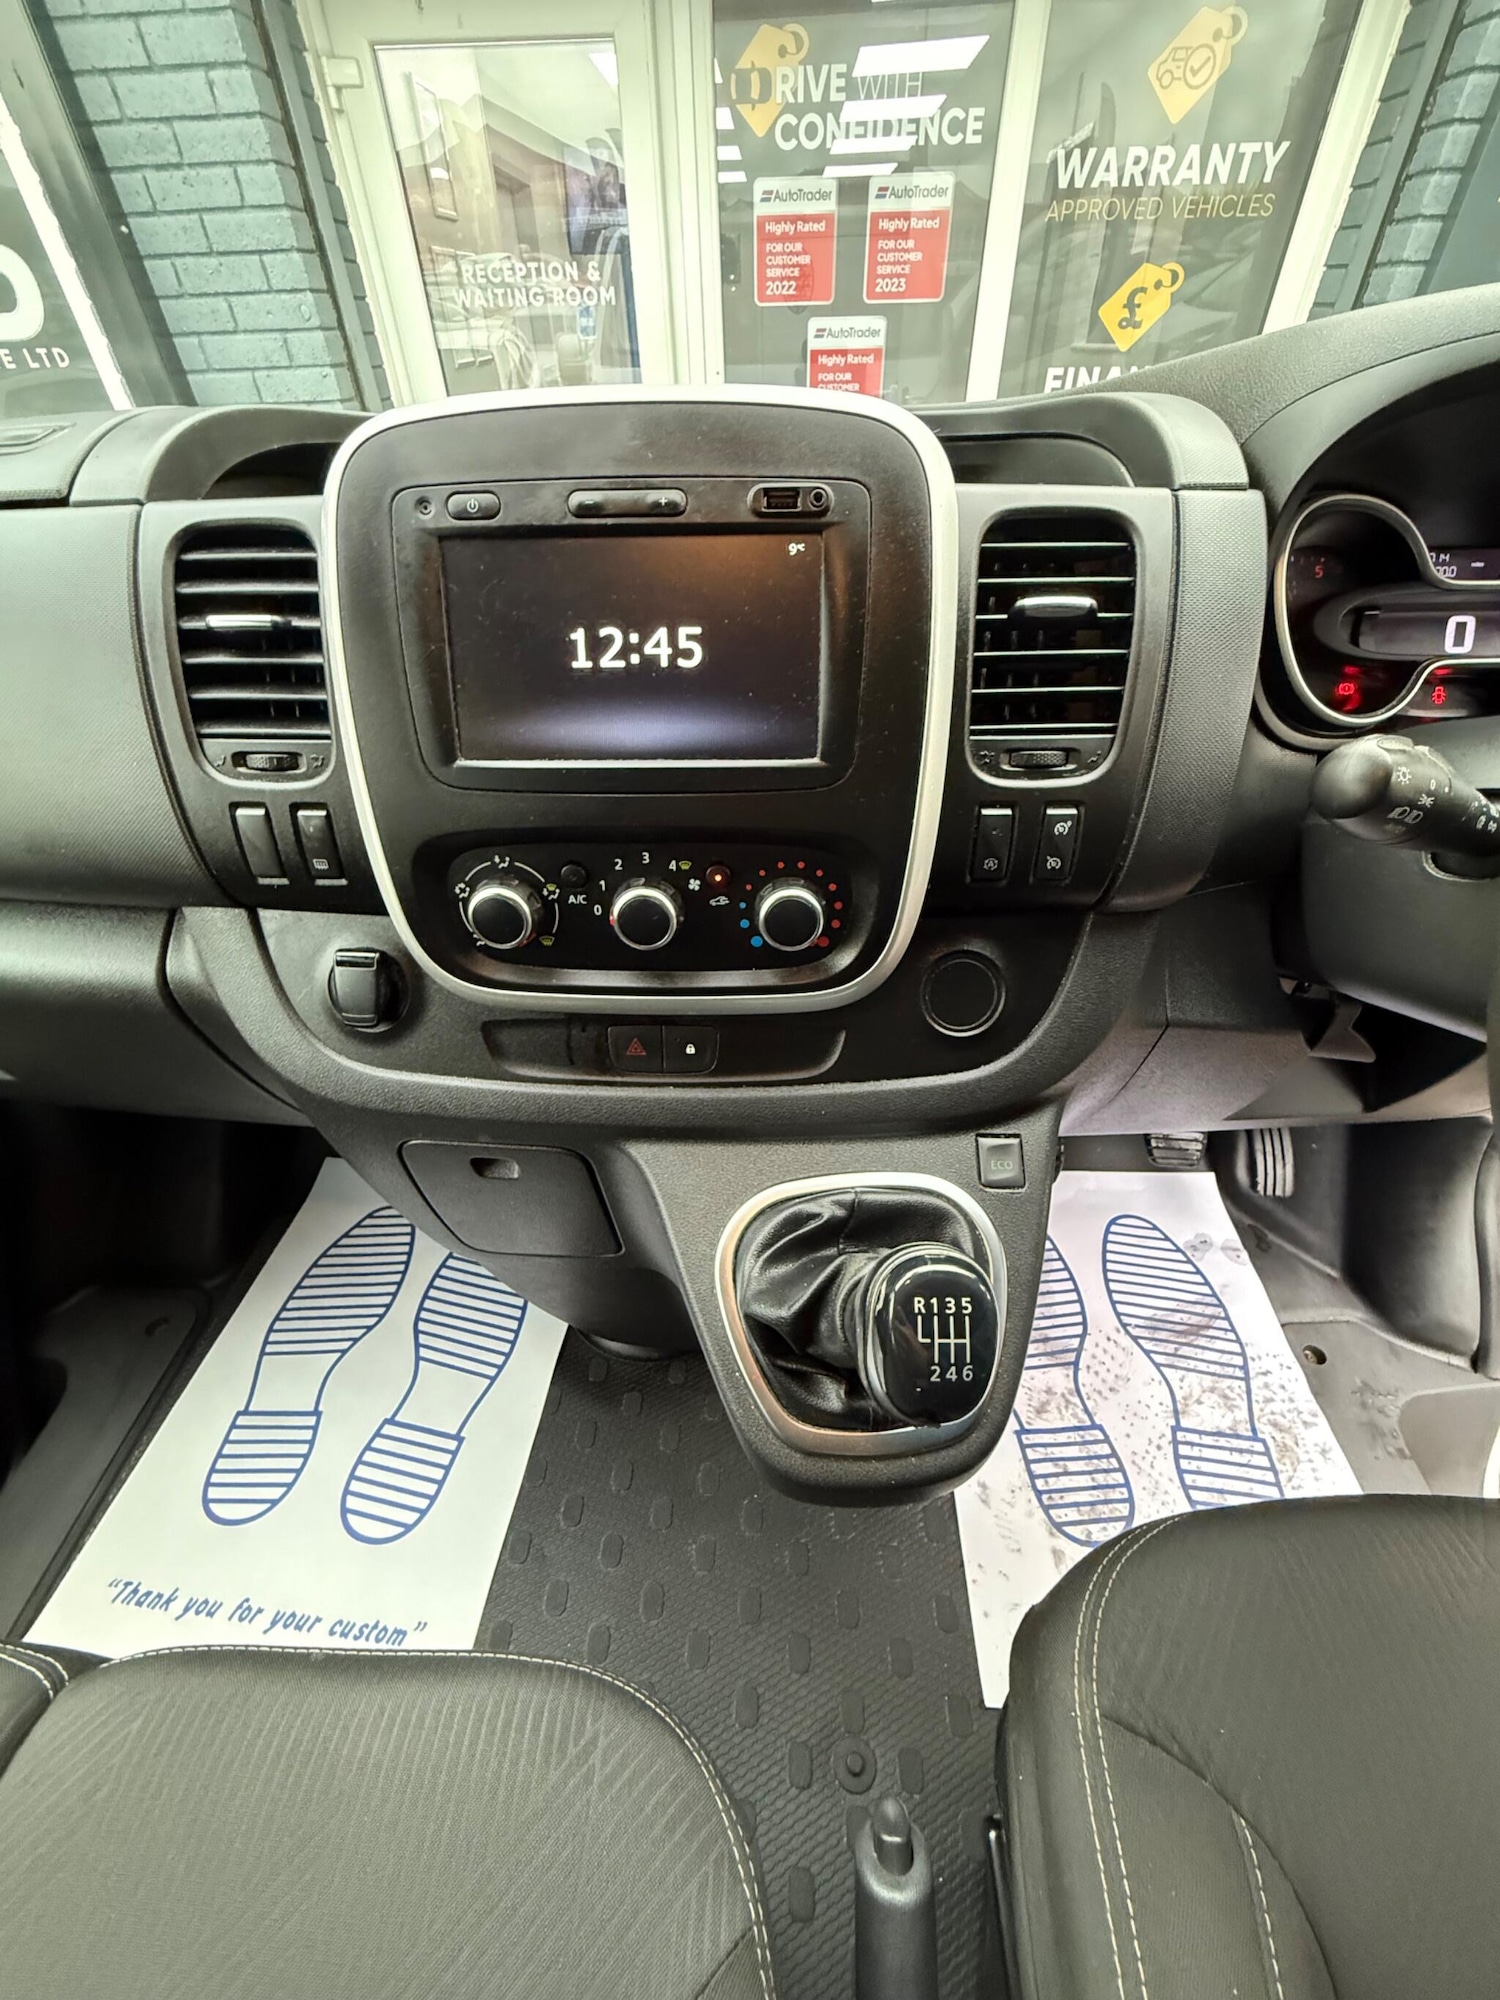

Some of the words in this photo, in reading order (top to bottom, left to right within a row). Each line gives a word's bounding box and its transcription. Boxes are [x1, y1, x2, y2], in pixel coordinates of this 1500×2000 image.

[1056, 141, 1291, 189] WARRANTY
[773, 188, 833, 203] AutoTrader
[888, 184, 949, 200] AutoTrader
[1045, 197, 1164, 222] APPROVED
[1171, 193, 1276, 220] VEHICLES
[765, 221, 796, 236] Highly
[797, 220, 826, 233] Rated
[878, 218, 910, 233] Highly
[910, 217, 940, 230] Rated
[765, 242, 783, 253] FOR
[783, 242, 803, 253] OUR
[878, 240, 896, 250] FOR
[896, 239, 915, 250] OUR
[766, 255, 811, 266] CUSTOMER
[877, 252, 923, 263] CUSTOMER
[461, 261, 579, 285] RECEPTION
[587, 261, 602, 281] &
[766, 267, 801, 278] SERVICE
[876, 265, 911, 275] SERVICE
[765, 280, 797, 296] 2022
[875, 278, 906, 293] 2023
[453, 287, 543, 309] WAITING
[551, 285, 616, 307] ROOM
[826, 325, 882, 339] AutoTrader
[22, 346, 71, 369] LTD
[817, 353, 846, 368] Highly
[847, 353, 875, 365] Rated
[817, 372, 834, 382] FOR
[834, 371, 853, 382] OUR
[1444, 614, 1477, 655] 0
[568, 626, 704, 670] 12:45
[613, 858, 624, 872] 2
[641, 851, 651, 865] 3
[667, 859, 678, 873] 4
[598, 879, 607, 893] 1
[567, 894, 588, 905] A/C
[990, 1159, 1014, 1171] ECO
[913, 1296, 926, 1314] R
[174, 1597, 224, 1622] you
[227, 1597, 265, 1624] for
[262, 1608, 323, 1635] your
